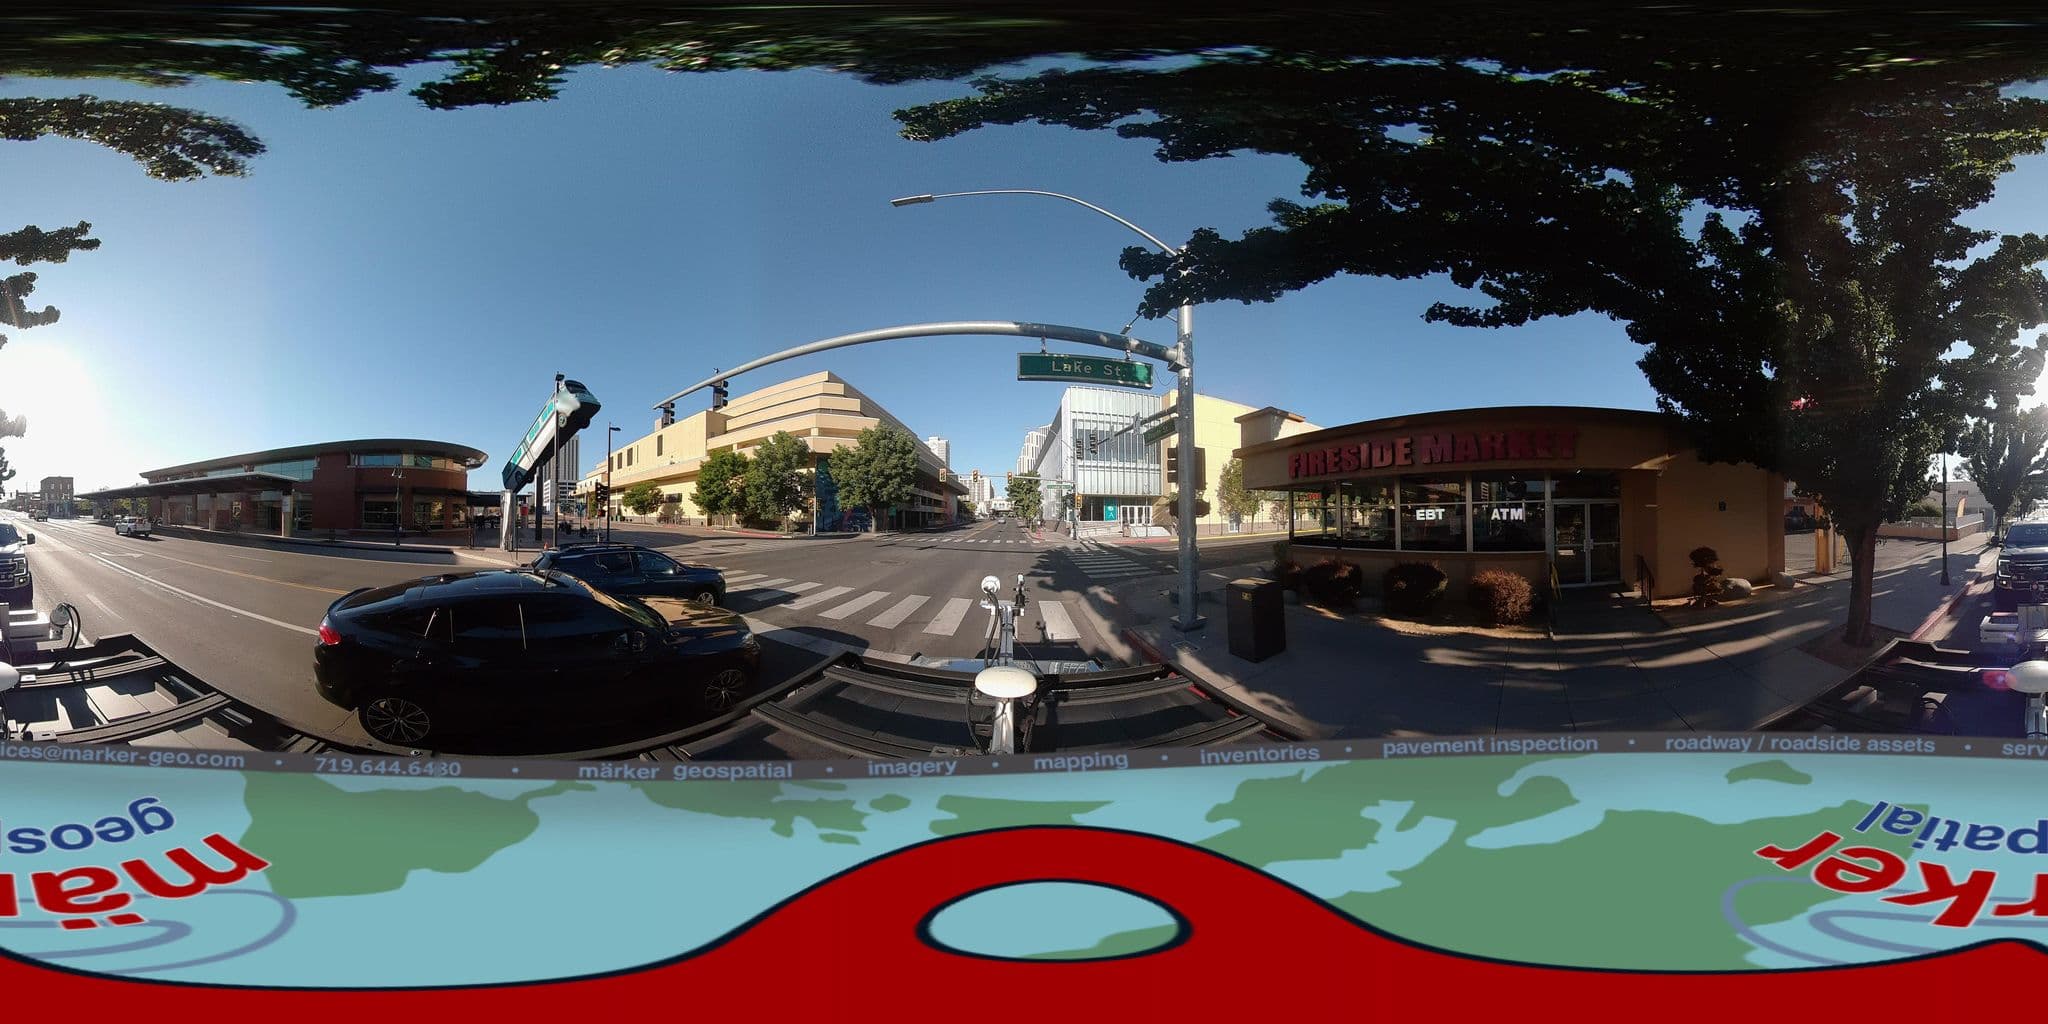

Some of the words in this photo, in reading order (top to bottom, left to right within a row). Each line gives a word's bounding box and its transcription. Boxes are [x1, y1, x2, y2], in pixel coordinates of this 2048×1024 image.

[1051, 360, 1093, 374] Lake
[1103, 365, 1126, 377] St.
[1288, 436, 1413, 479] FIRESIDE
[1420, 430, 1577, 464] MARKET
[1415, 508, 1446, 521] EBT
[1490, 508, 1524, 521] ATM
